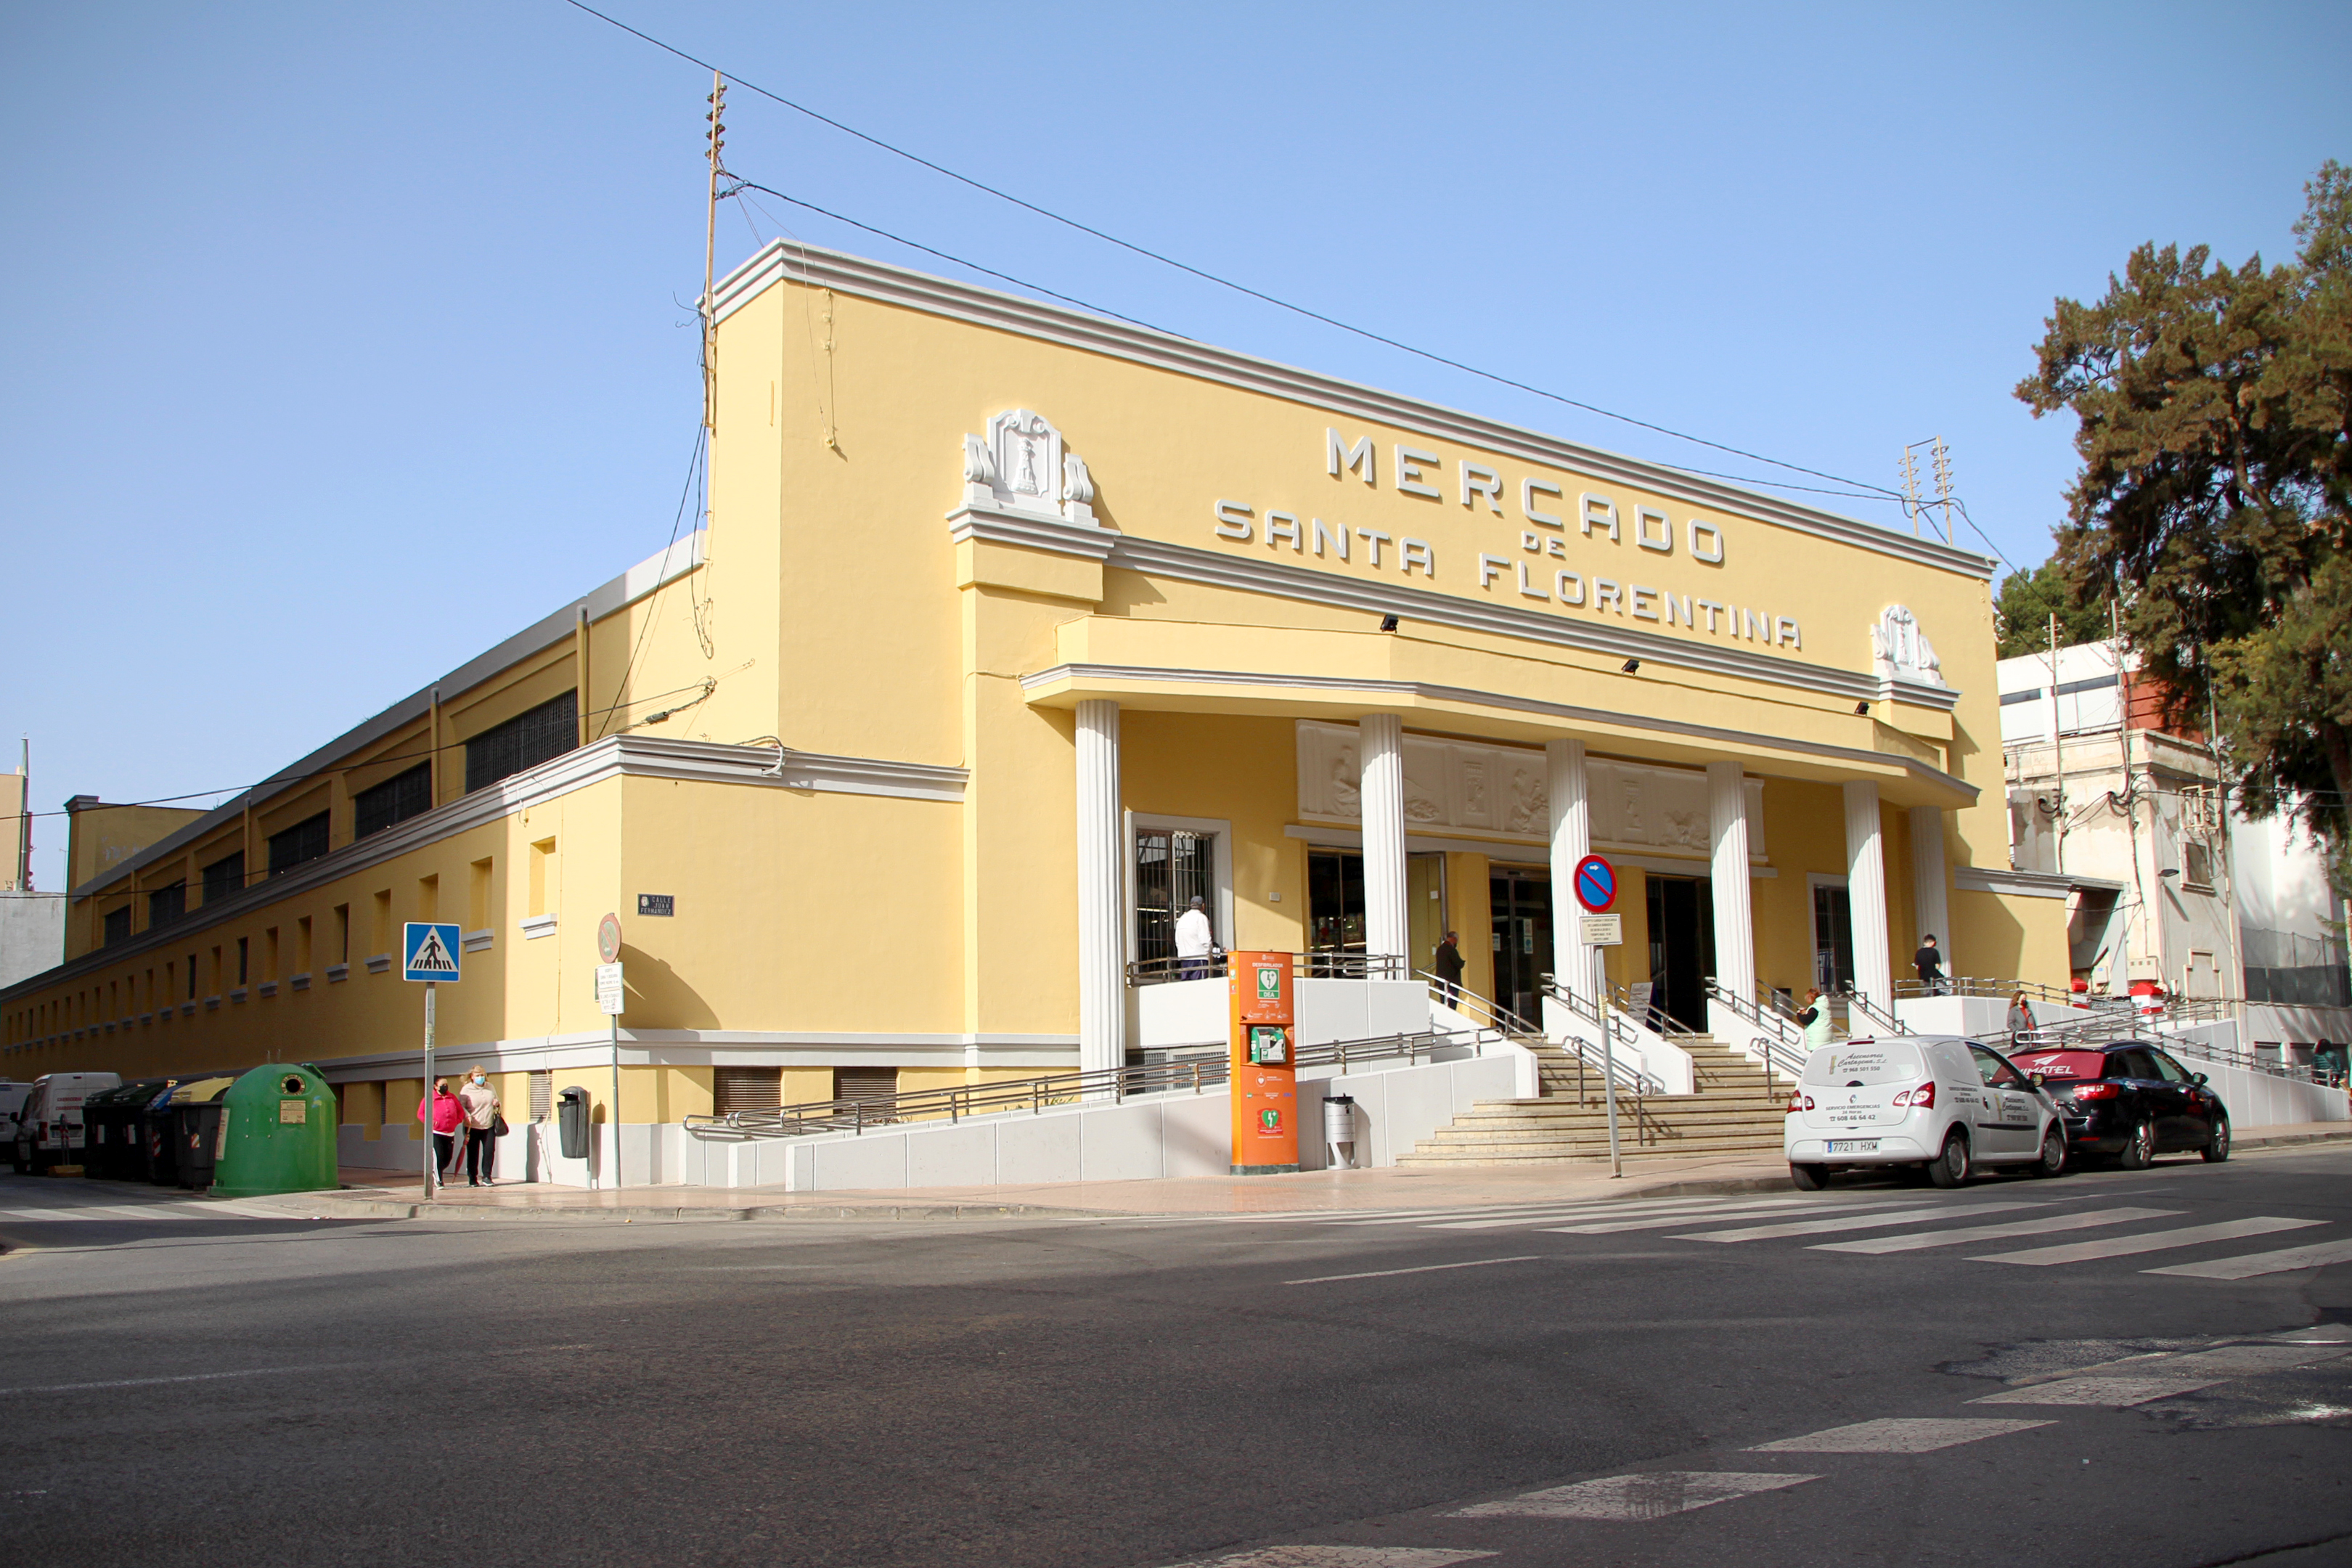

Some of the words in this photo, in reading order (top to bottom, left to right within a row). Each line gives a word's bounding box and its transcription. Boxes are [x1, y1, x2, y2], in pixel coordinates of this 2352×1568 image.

[1326, 427, 1723, 564] MERCADO
[1214, 498, 1433, 575] SANTA
[1479, 552, 1800, 648] FLORENTINA
[1521, 530, 1565, 556] DE
[1833, 1142, 1853, 1152] 7721
